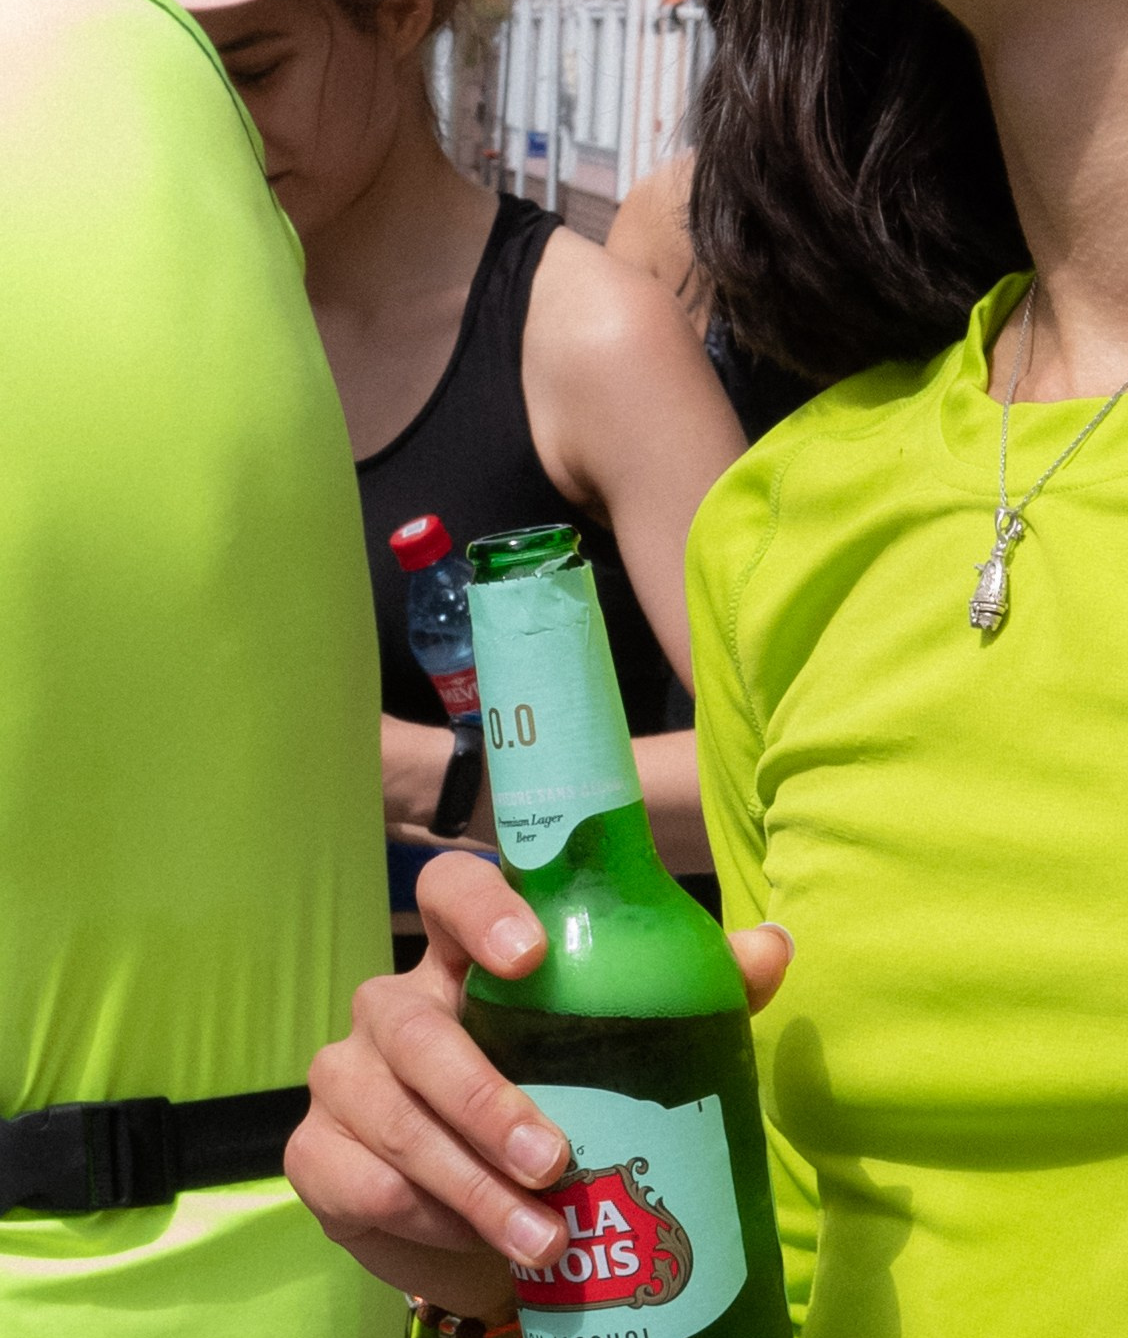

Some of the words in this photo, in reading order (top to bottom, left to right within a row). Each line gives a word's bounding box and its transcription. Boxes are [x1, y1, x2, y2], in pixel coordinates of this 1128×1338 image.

[489, 704, 537, 749] 0.0
[531, 813, 564, 829] Lager
[516, 831, 537, 843] Beer
[563, 1200, 633, 1240] LA
